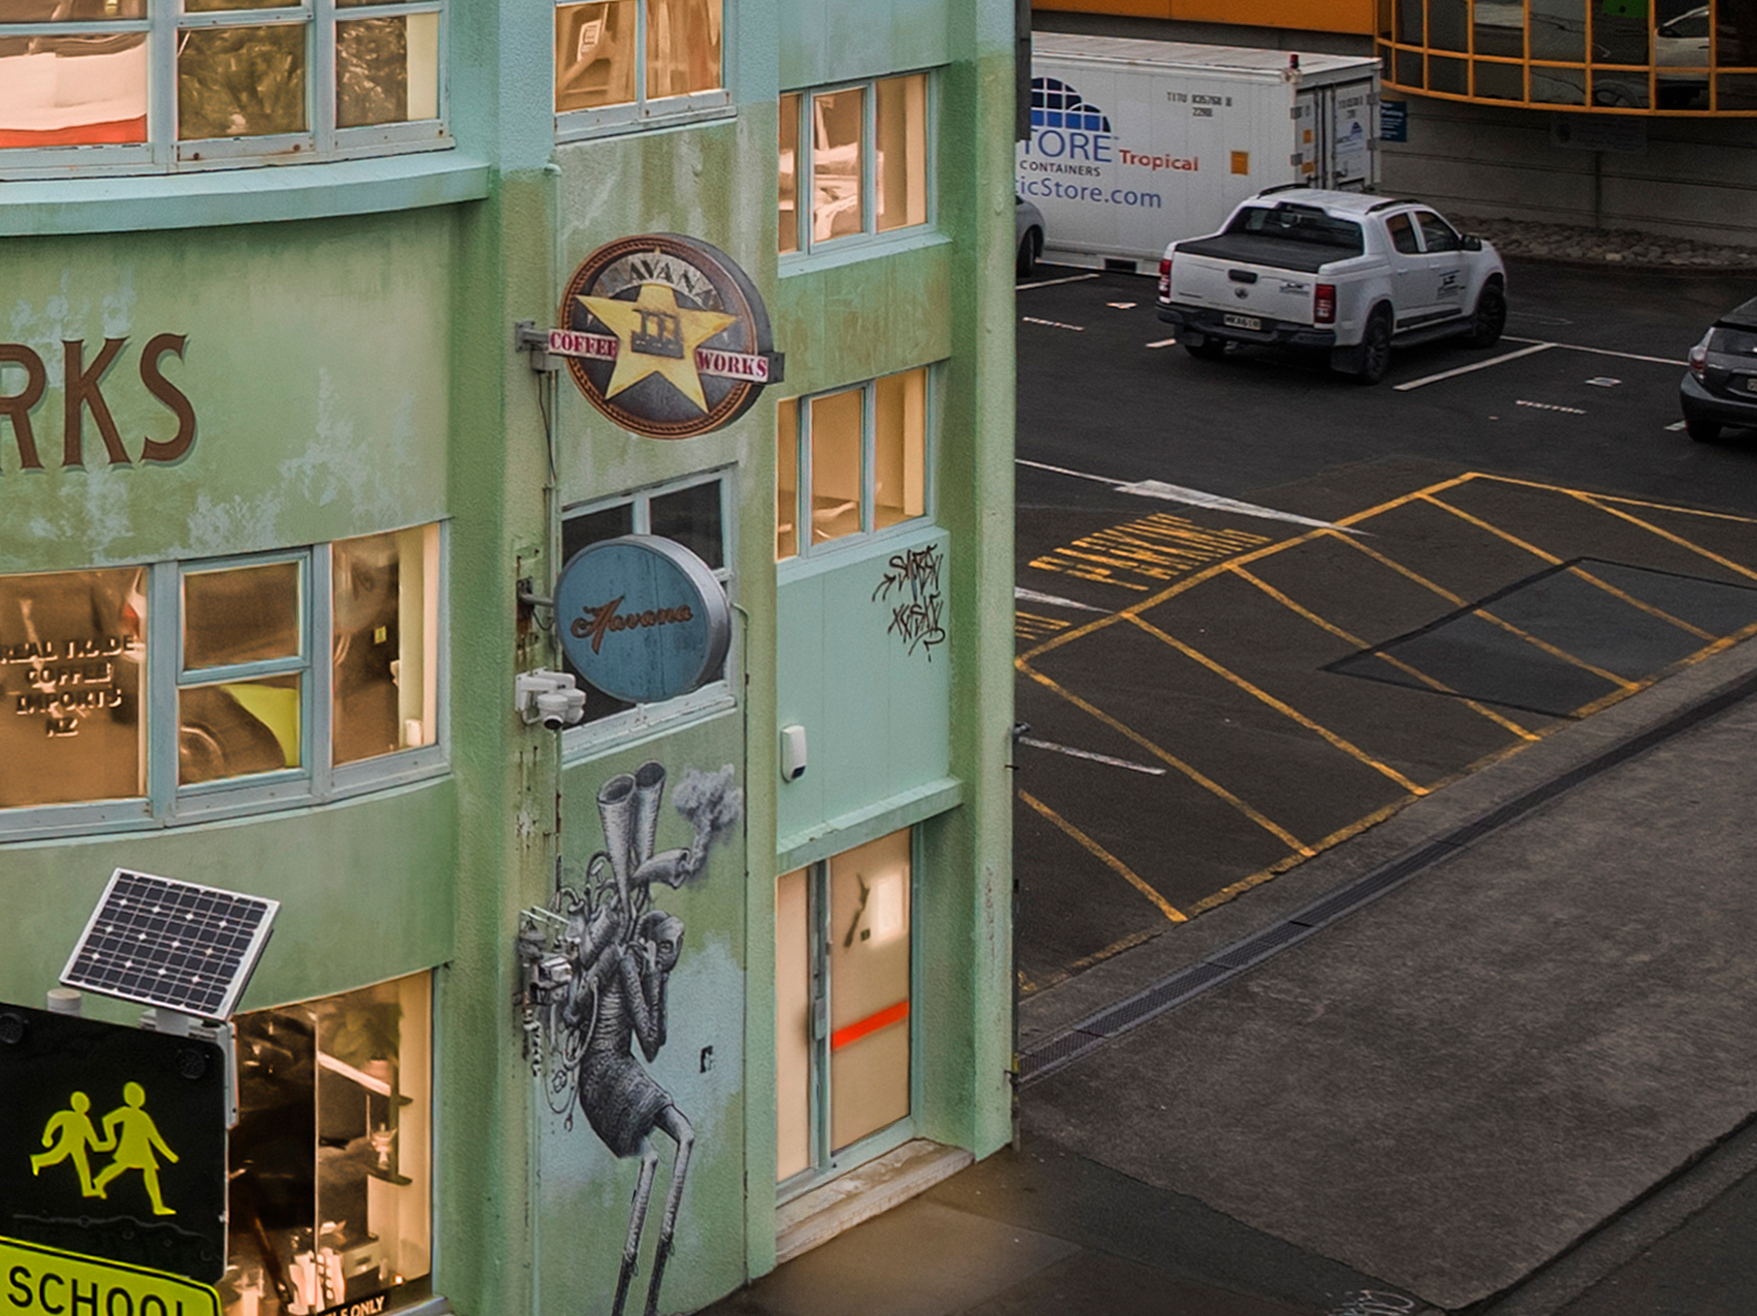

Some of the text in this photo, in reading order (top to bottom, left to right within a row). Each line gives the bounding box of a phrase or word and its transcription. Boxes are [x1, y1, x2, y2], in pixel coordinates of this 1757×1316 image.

[1019, 160, 1101, 177] CONTAINERS
[1118, 149, 1199, 172] Tropical
[549, 331, 768, 378] COFFEE WORKS
[570, 595, 694, 655] Havana
